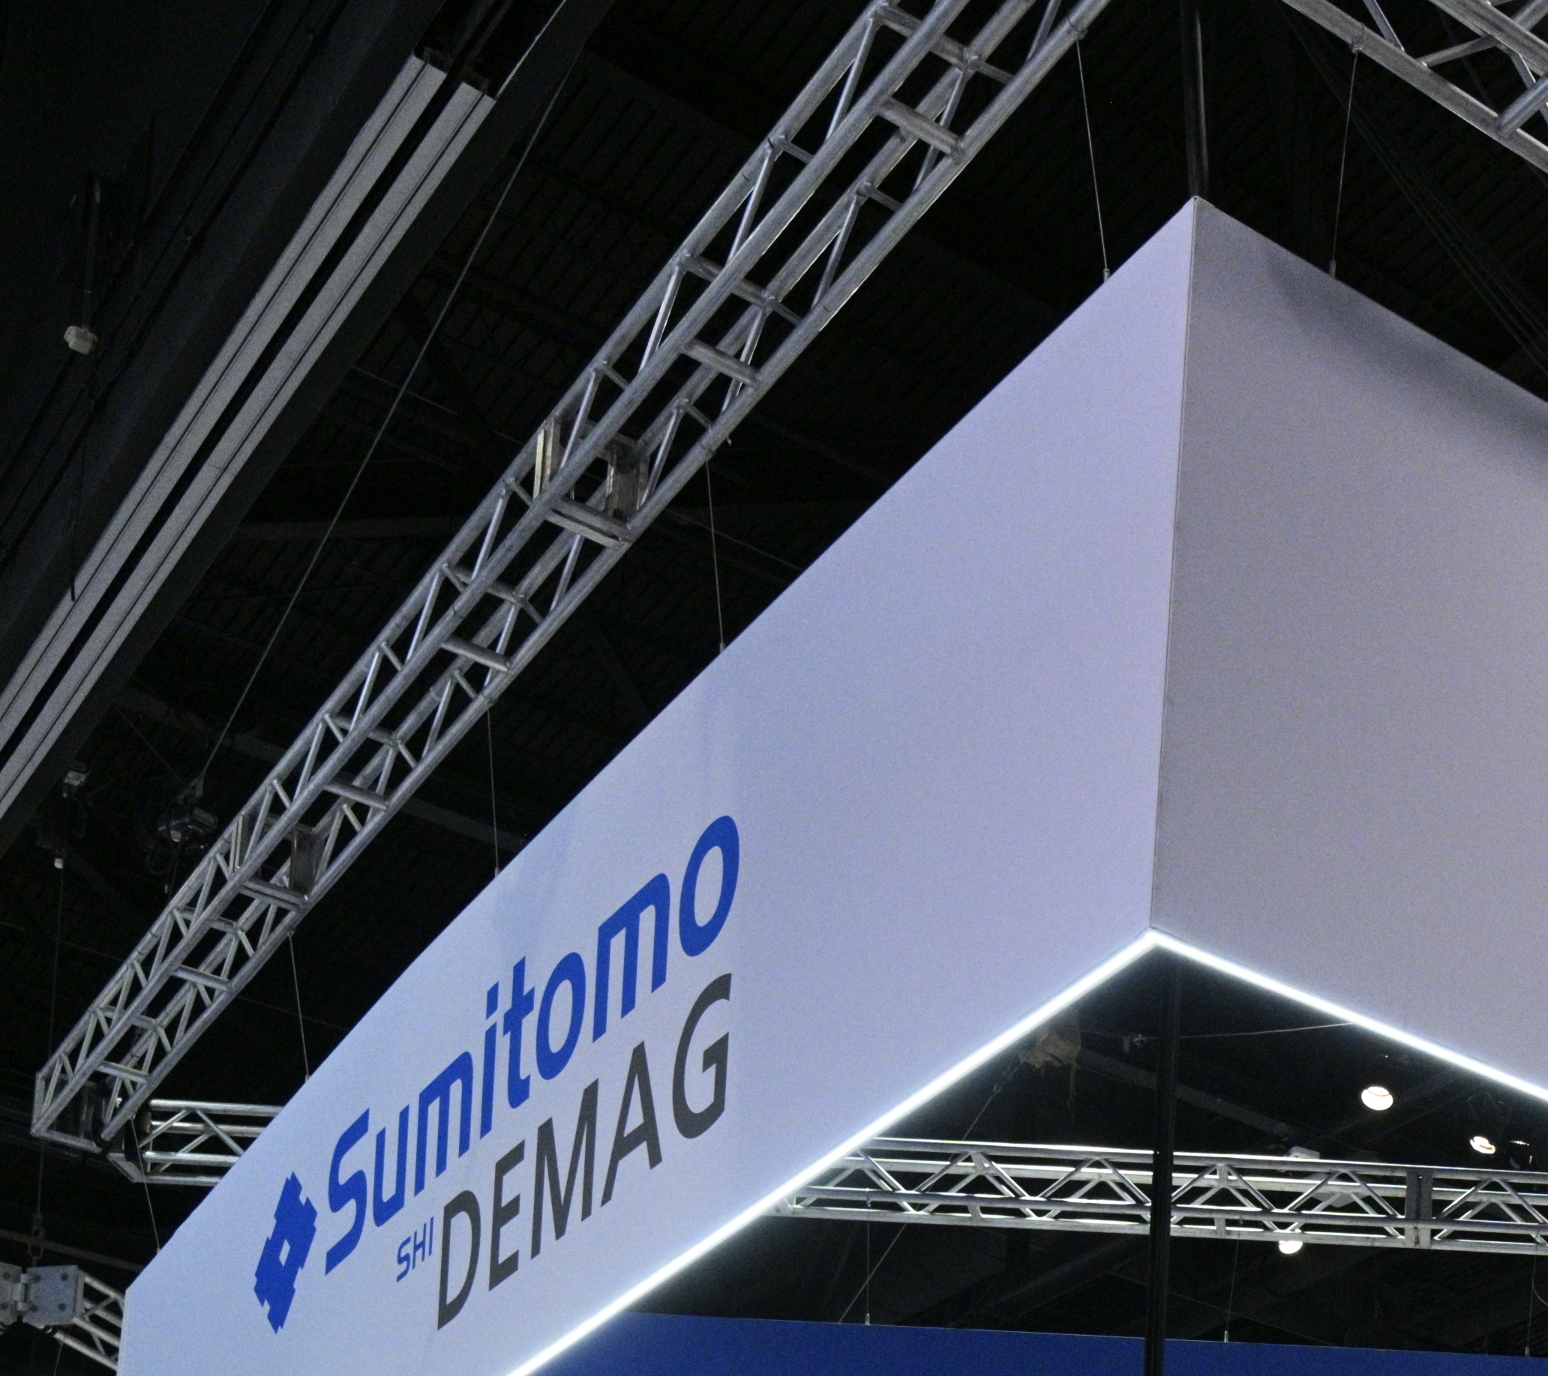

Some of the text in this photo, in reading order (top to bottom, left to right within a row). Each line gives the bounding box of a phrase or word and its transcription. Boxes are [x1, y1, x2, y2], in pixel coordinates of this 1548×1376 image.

[325, 814, 740, 1276] Sumitomo
[396, 971, 732, 1331] SHI DEMAG
